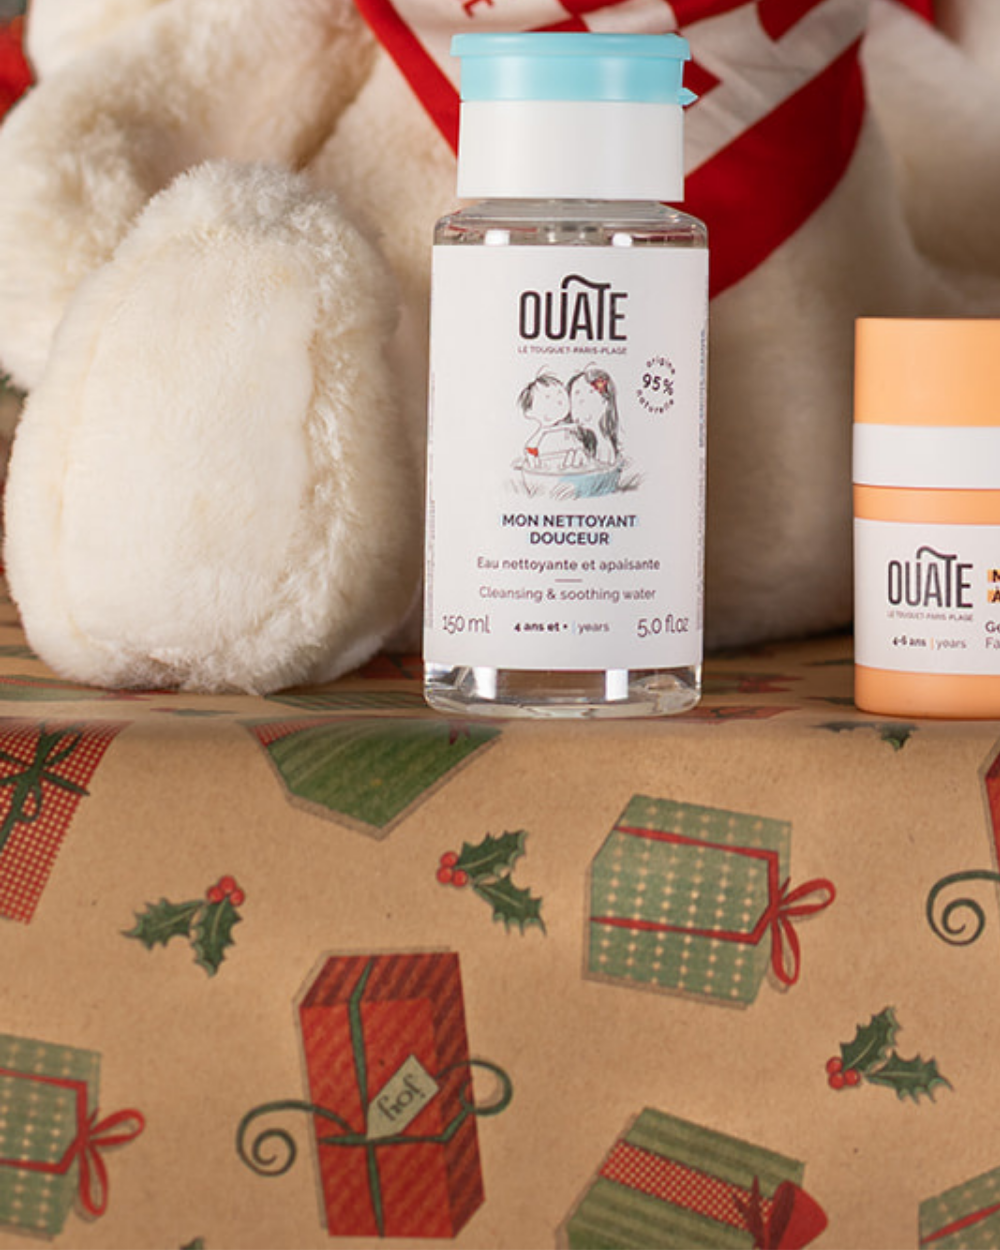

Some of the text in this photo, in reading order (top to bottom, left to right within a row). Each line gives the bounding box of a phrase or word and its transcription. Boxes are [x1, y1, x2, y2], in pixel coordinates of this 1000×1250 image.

[518, 274, 628, 341] OUATE
[501, 514, 637, 528] MON NETTOYANT
[529, 532, 610, 546] DOUCEUR
[477, 557, 661, 572] Eau nettoyante et apaisante
[887, 546, 974, 609] OUATE
[479, 586, 657, 603] Cleansing & soothing water
[442, 614, 491, 634] 150 ml
[514, 622, 521, 633] 4
[523, 623, 545, 633] ans
[577, 623, 610, 635] years
[909, 637, 927, 647] ans
[936, 638, 967, 651] years
